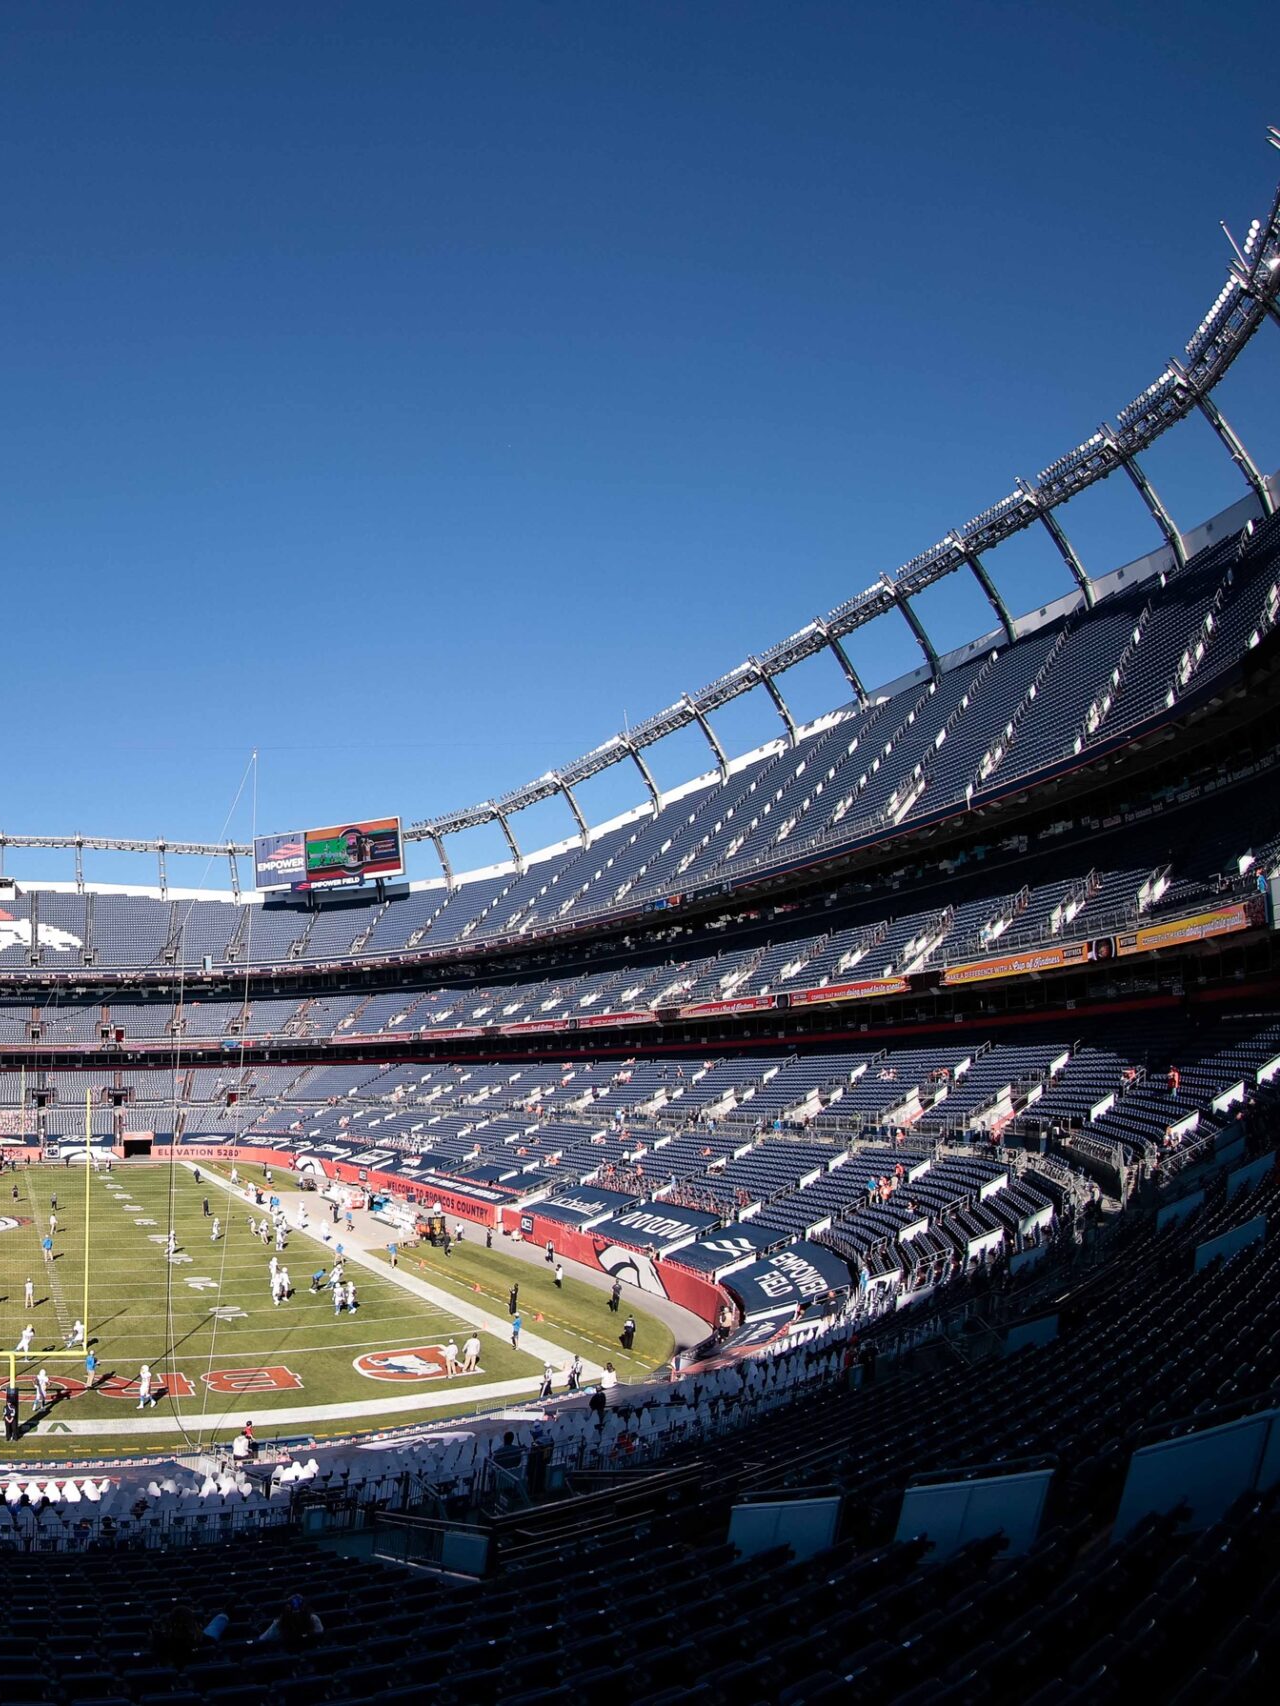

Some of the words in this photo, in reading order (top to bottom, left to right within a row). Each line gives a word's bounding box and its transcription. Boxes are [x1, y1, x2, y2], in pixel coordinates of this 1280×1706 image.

[257, 858, 305, 872] EMPOWER
[310, 879, 342, 889] EMPOWER
[342, 876, 360, 885] FIELD
[1013, 961, 1025, 971] Cup
[1026, 958, 1033, 969] of
[1032, 956, 1060, 968] Kindness
[386, 1180, 415, 1196] WELCOME
[415, 1188, 425, 1198] TO
[456, 1201, 489, 1219] COUNTRY
[612, 1211, 699, 1238] ARROW
[753, 1270, 793, 1297] FIELD
[768, 1251, 829, 1297] EMPOWER
